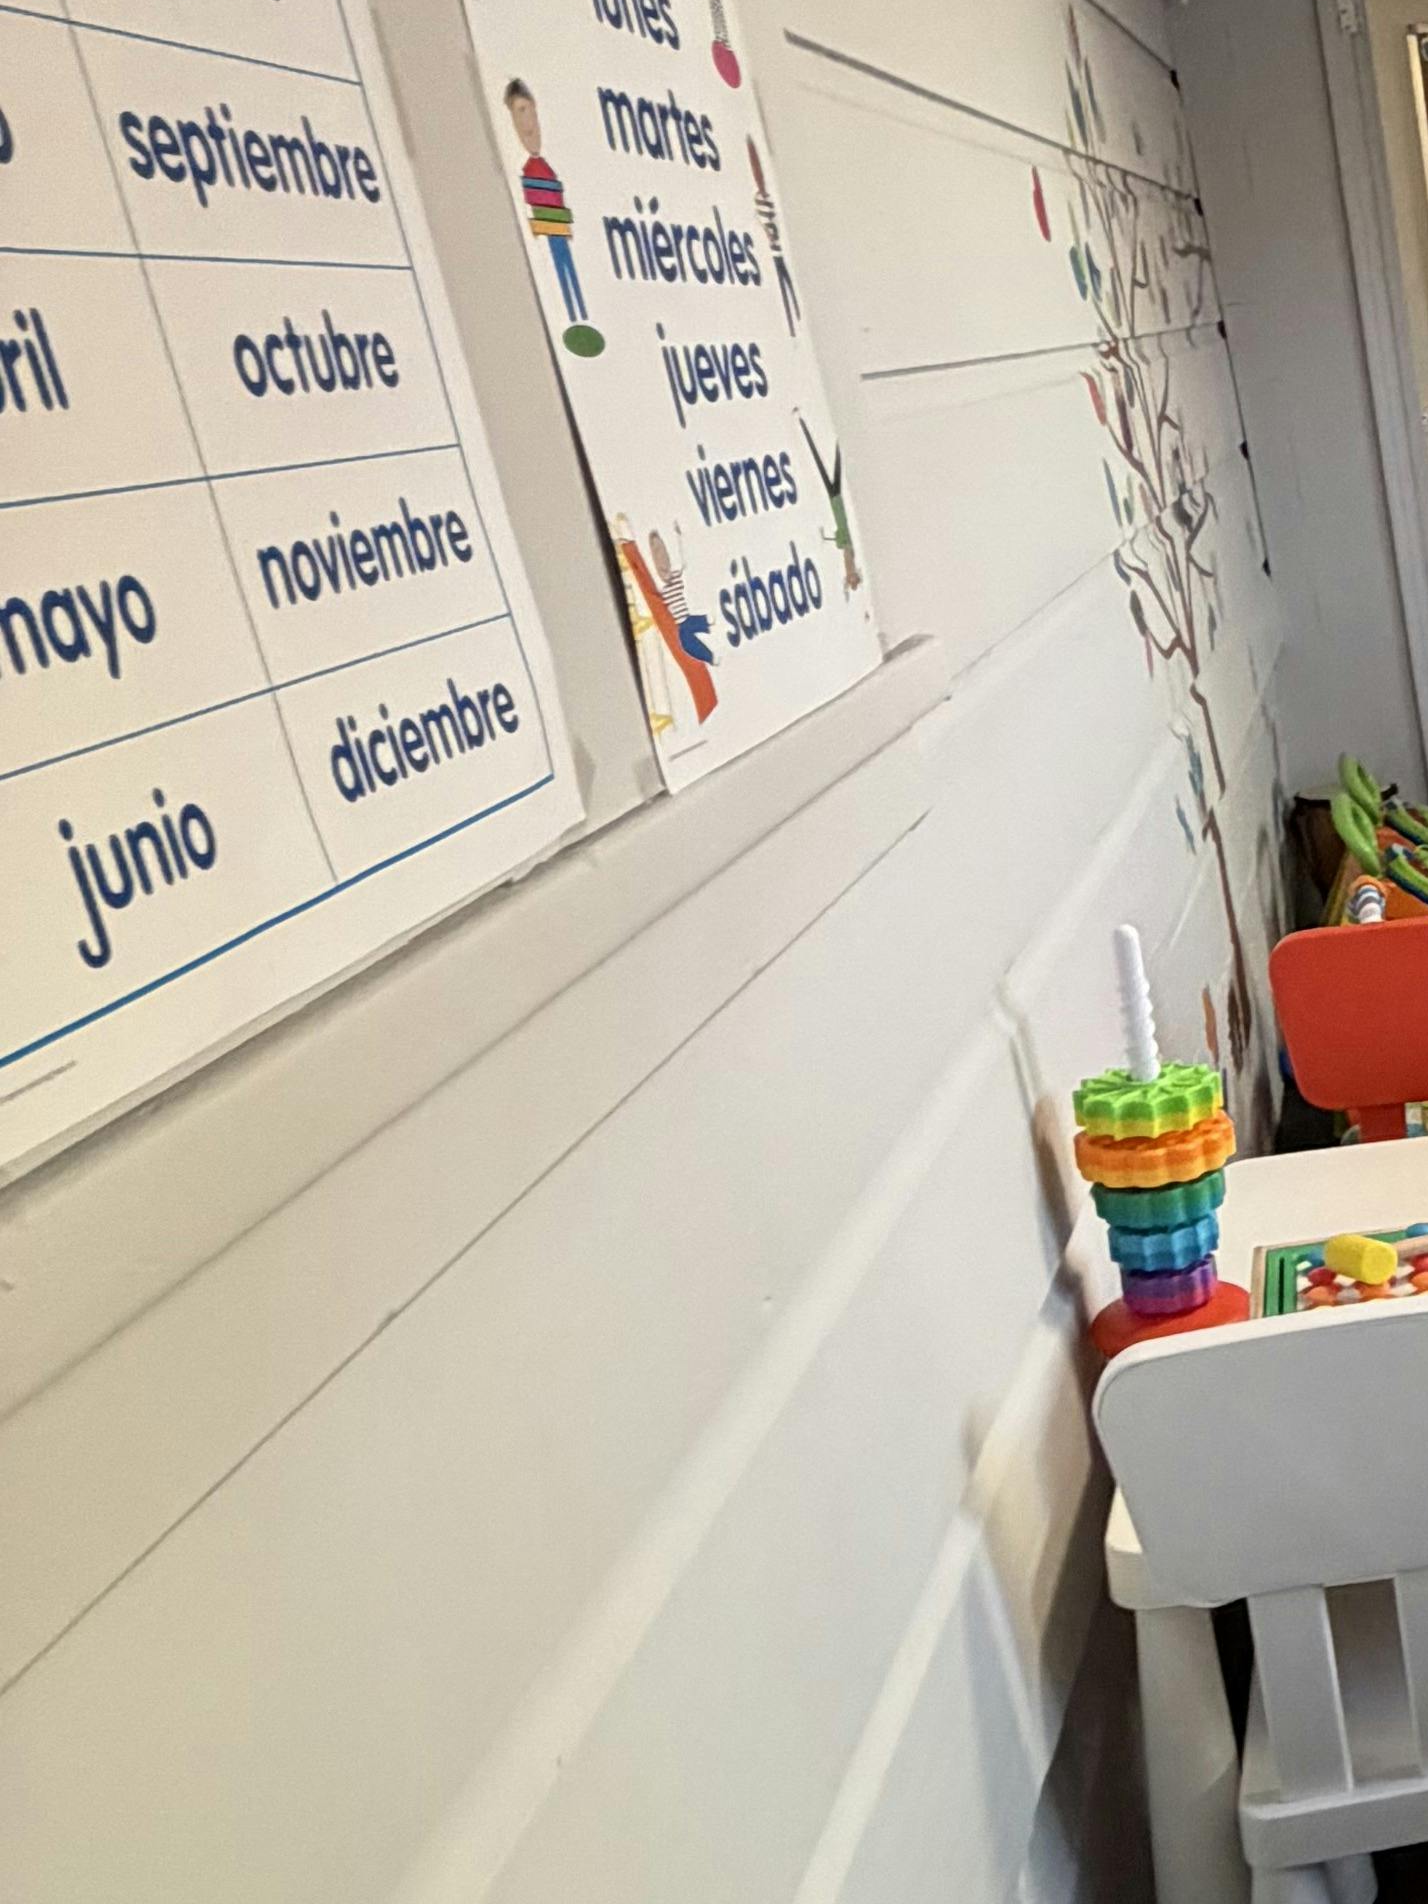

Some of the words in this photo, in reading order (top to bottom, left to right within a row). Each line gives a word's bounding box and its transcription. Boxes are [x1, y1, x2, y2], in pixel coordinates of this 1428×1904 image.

[119, 104, 380, 207] septiembre
[598, 86, 720, 171] martes
[603, 195, 762, 286] miércoles
[0, 308, 69, 413] ril
[233, 309, 400, 397] octubre
[656, 322, 768, 429] jueves
[686, 443, 798, 527] viernes
[256, 496, 474, 610] noviembre
[718, 540, 823, 648] sábado
[330, 678, 520, 803] diciembre
[58, 788, 217, 969] junio
